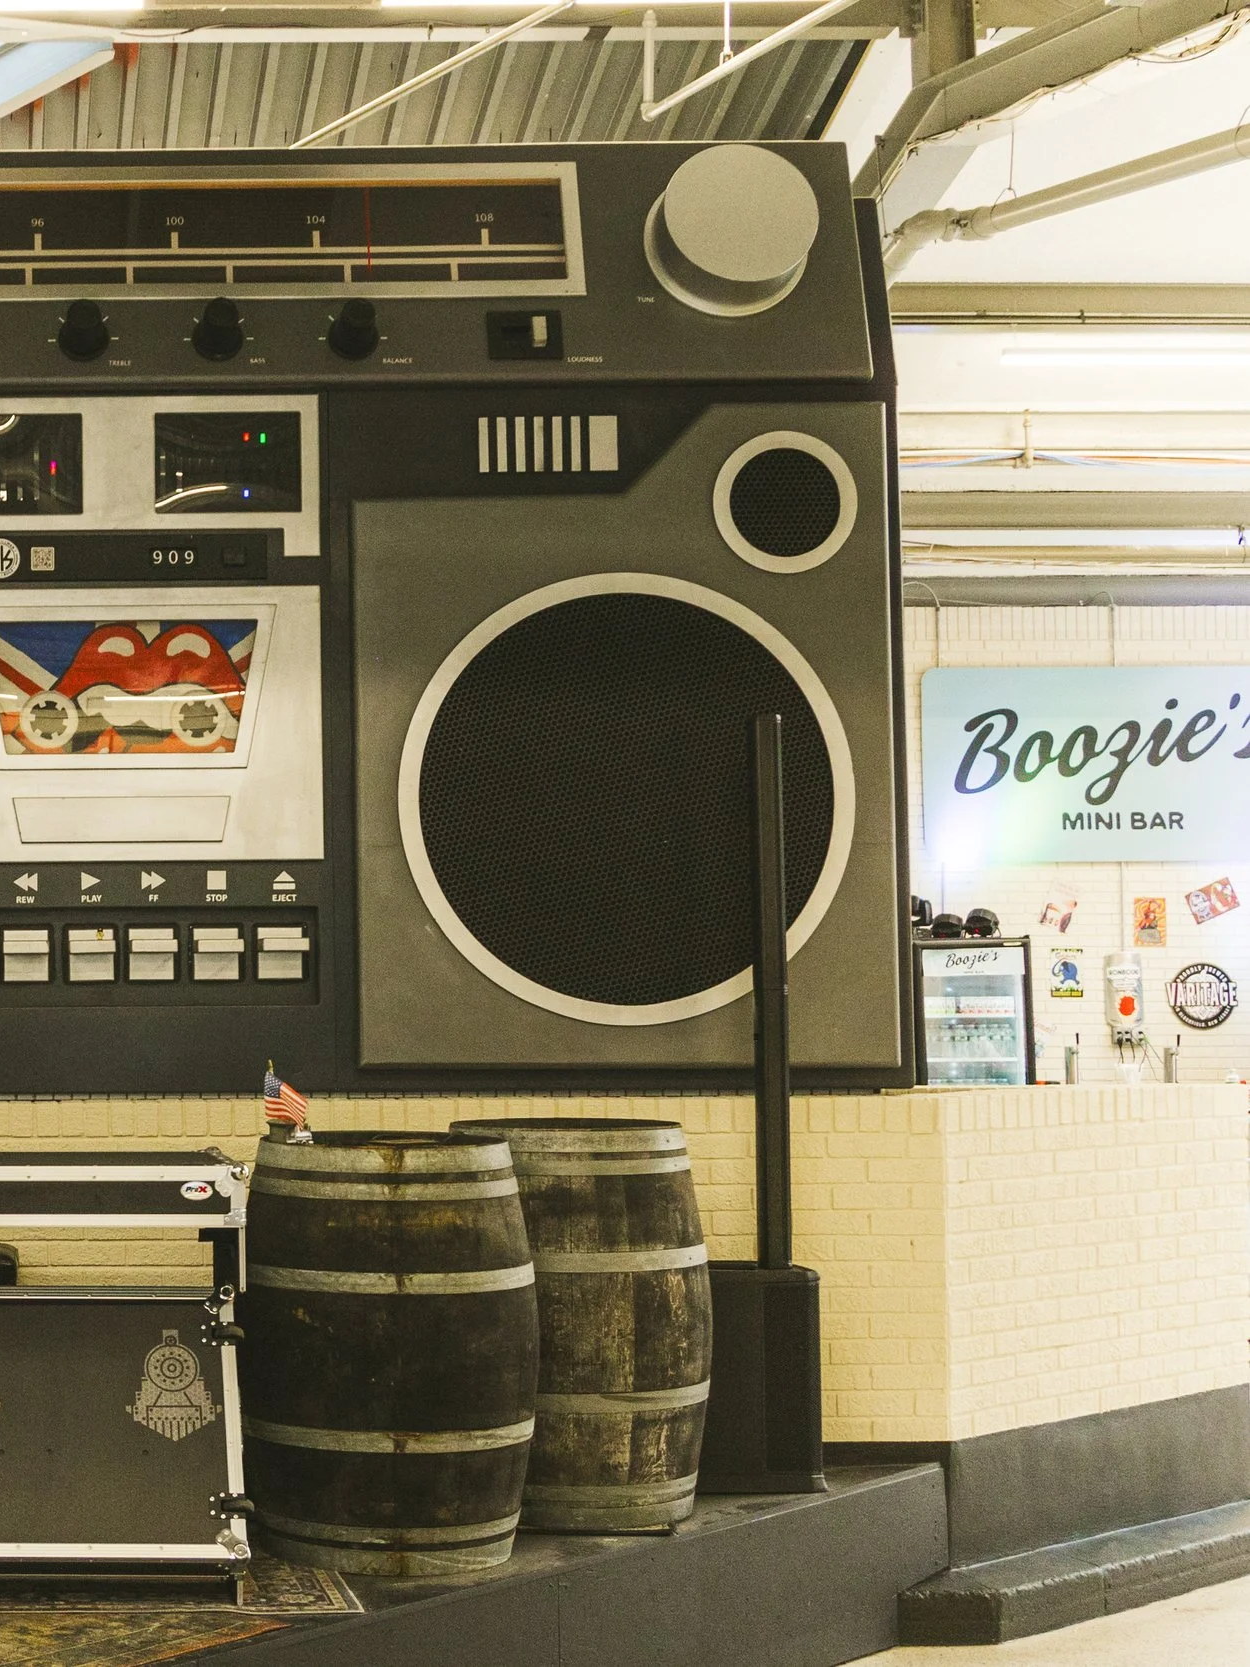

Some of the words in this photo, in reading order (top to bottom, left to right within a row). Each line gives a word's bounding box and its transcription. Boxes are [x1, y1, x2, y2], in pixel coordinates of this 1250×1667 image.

[165, 216, 185, 226] 100
[306, 215, 326, 225] 104
[474, 212, 495, 223] 108
[31, 218, 45, 228] 96
[1062, 812, 1121, 830] MINI
[1130, 812, 1184, 830] BAR
[16, 895, 35, 904] REW
[81, 894, 102, 903] PLAY
[148, 894, 159, 902] FF
[205, 894, 228, 902] STOP
[272, 893, 297, 902] EJECT
[946, 950, 1001, 969] Boozie's
[1165, 982, 1238, 1007] VARITAGE
